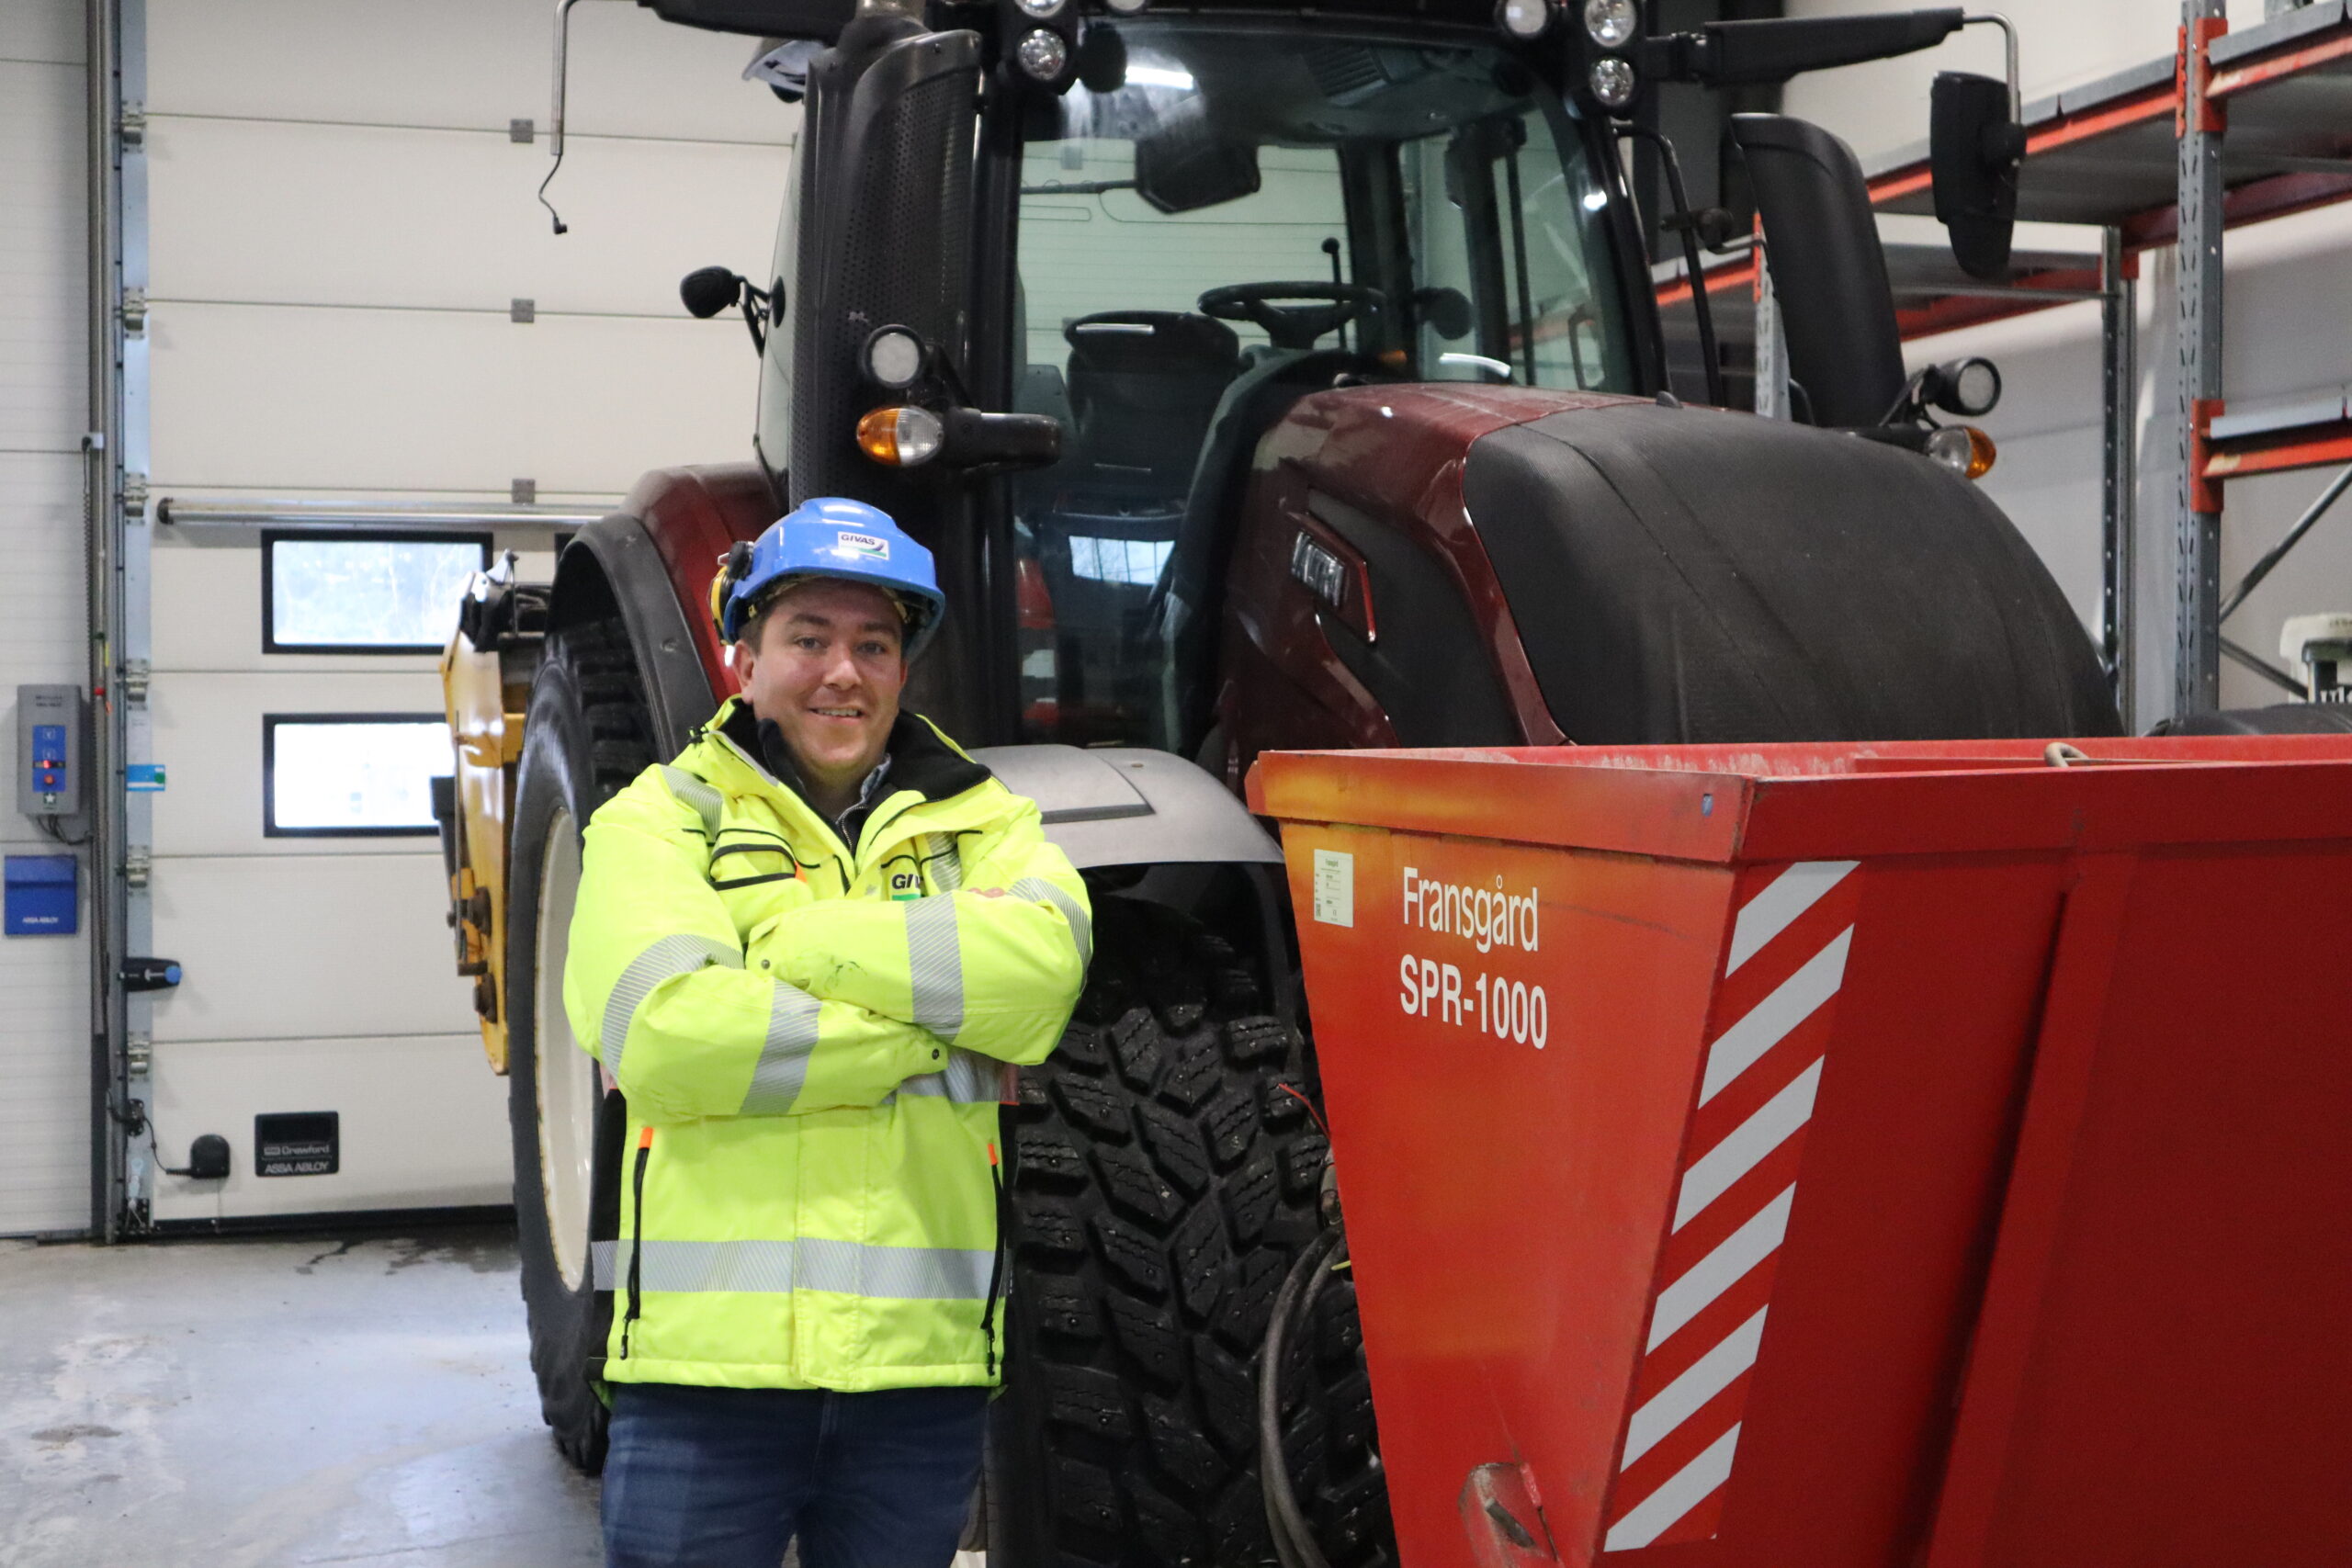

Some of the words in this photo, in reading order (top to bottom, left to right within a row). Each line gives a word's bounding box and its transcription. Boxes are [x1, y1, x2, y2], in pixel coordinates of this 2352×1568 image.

[841, 534, 876, 546] GIVAS
[1403, 866, 1539, 953] Fransgård
[1400, 953, 1547, 1050] SPR-1000
[281, 1145, 330, 1156] Crawford
[264, 1162, 293, 1174] ASSA
[294, 1161, 330, 1173] ABLOY
